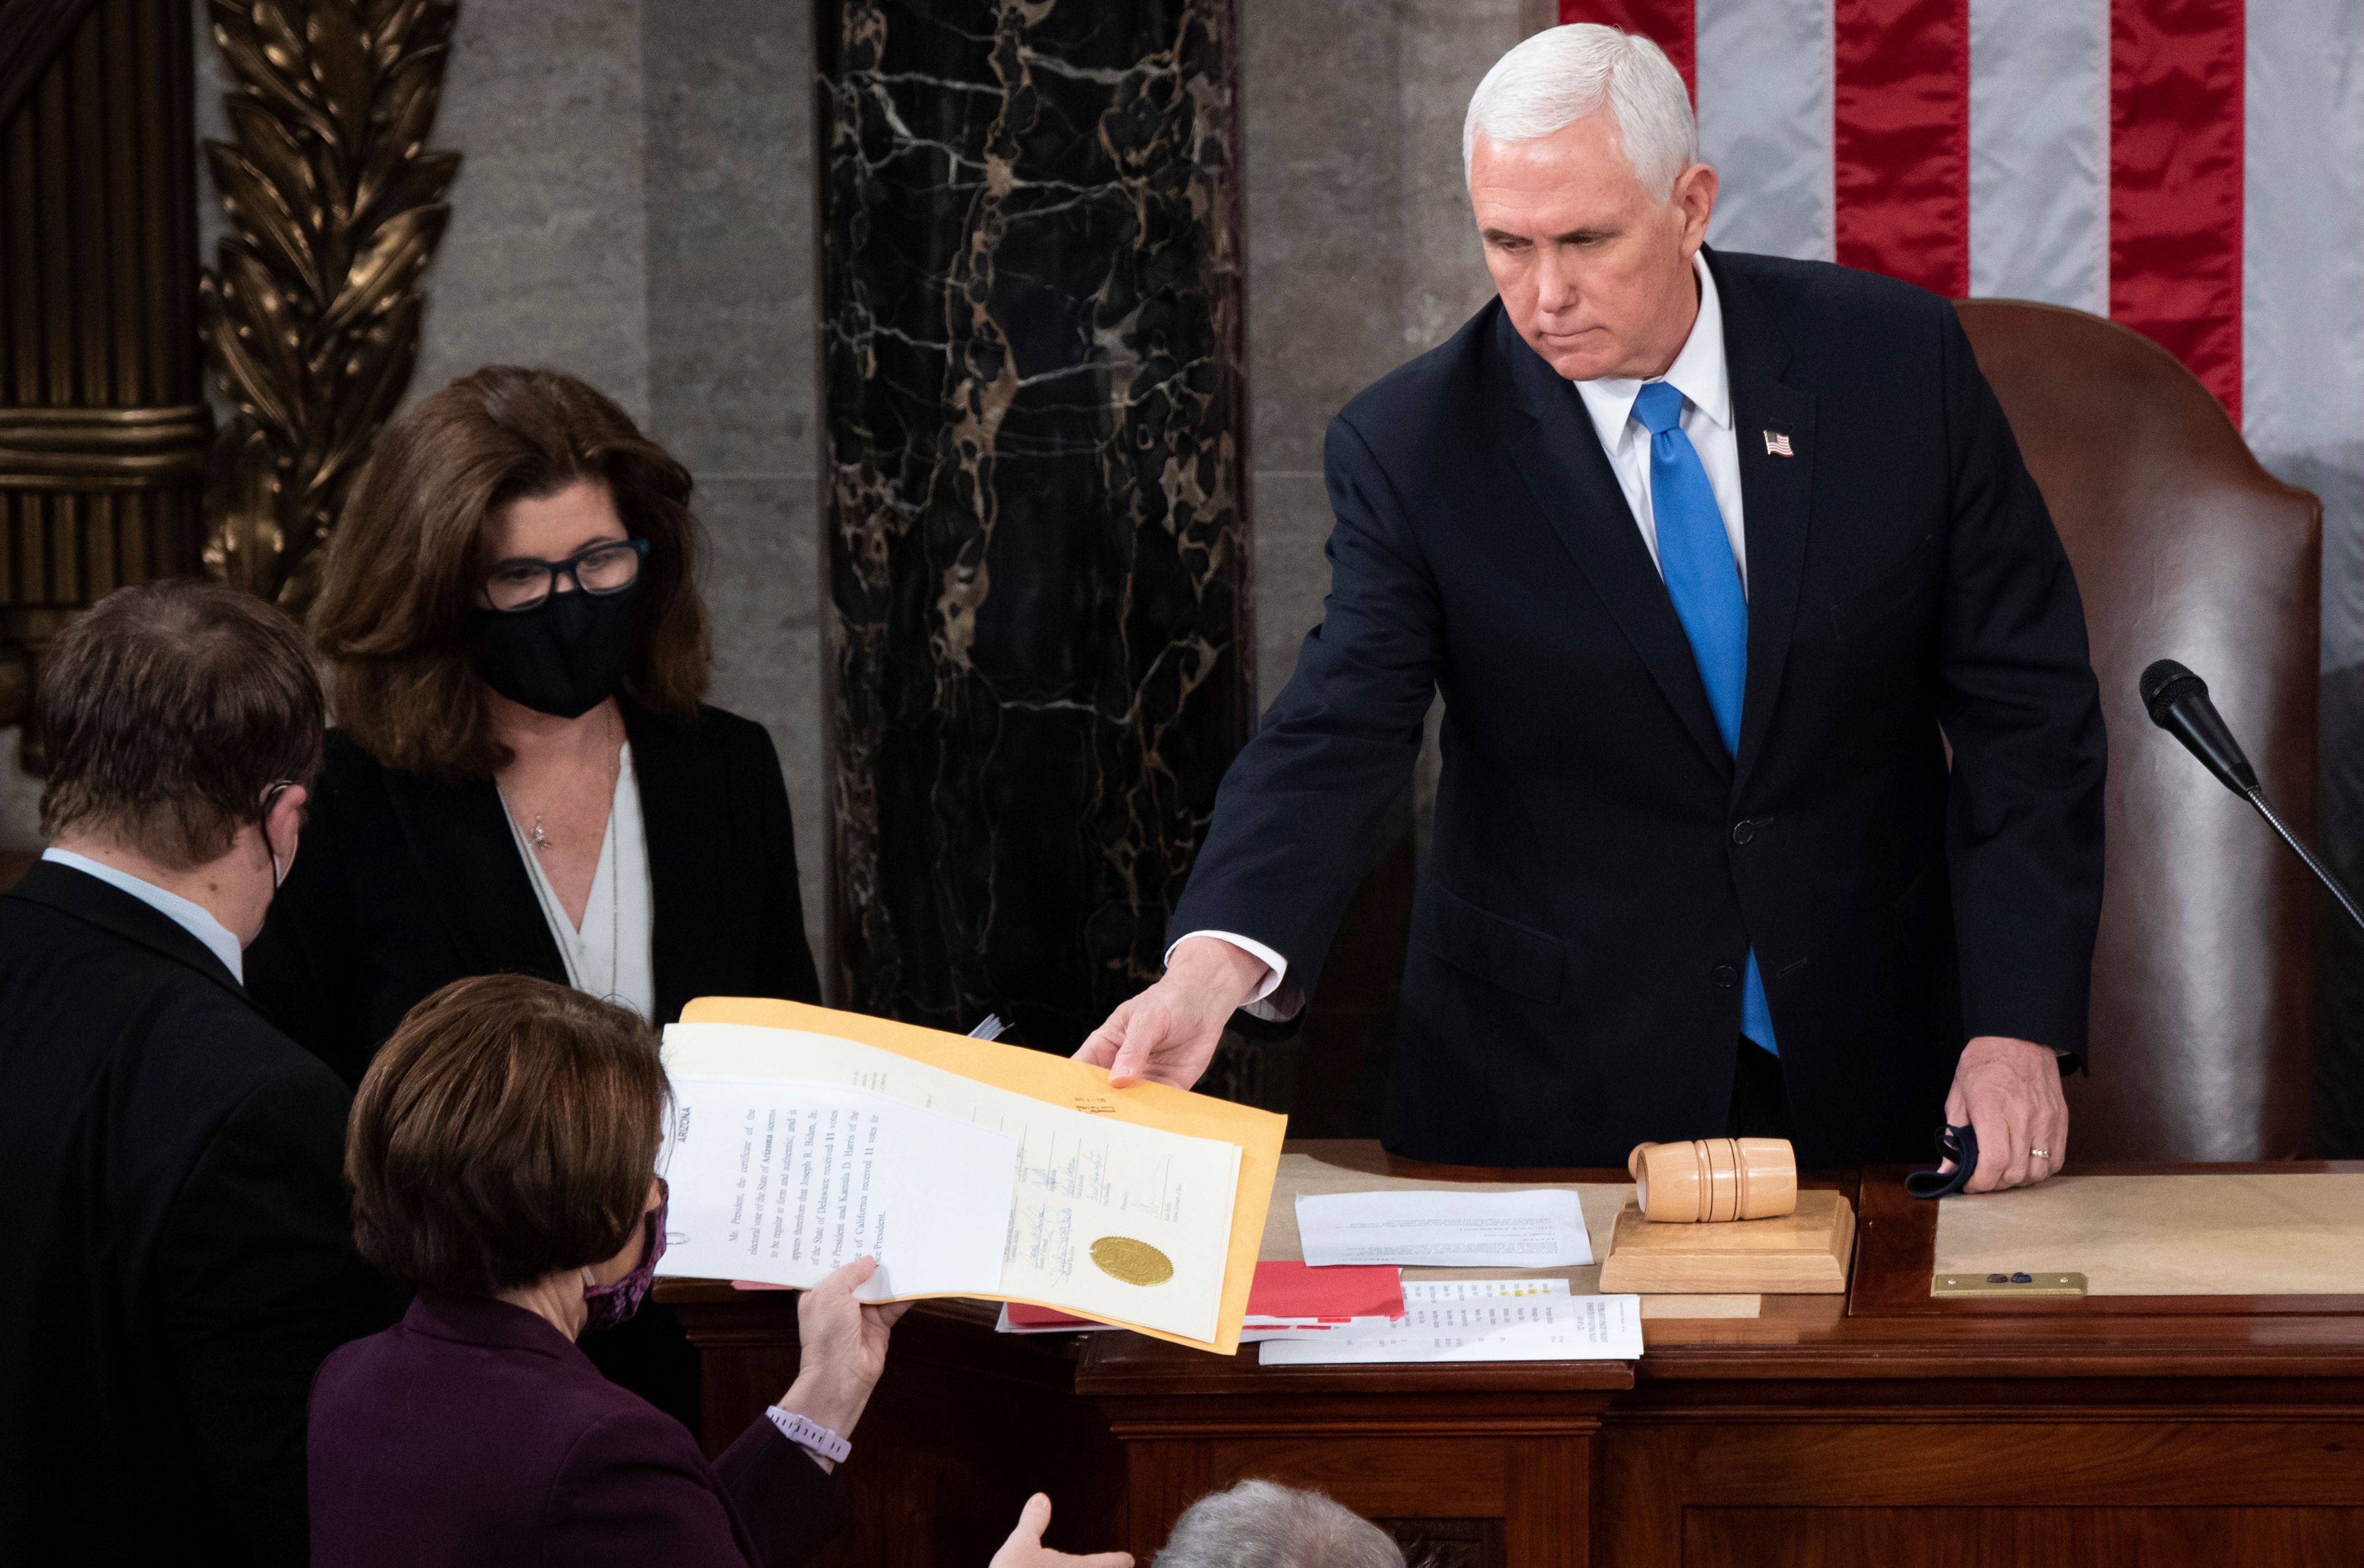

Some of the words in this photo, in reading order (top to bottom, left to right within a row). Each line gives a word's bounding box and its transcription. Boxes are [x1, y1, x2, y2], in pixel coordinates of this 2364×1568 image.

[746, 1108, 755, 1120] the
[768, 1108, 776, 1132] seems
[808, 1109, 817, 1119] Jr.
[830, 1109, 838, 1128] votes
[849, 1111, 859, 1120] the
[678, 1106, 691, 1143] ARIZONA
[744, 1125, 753, 1135] of
[787, 1117, 795, 1132] and
[848, 1122, 856, 1132] of
[805, 1122, 816, 1146] Biden,
[826, 1132, 835, 1141] 11
[869, 1127, 877, 1143] votes
[762, 1133, 773, 1163] Arizona
[782, 1135, 794, 1171] authentic,
[803, 1149, 812, 1158] R.
[843, 1134, 855, 1156] Harris
[740, 1141, 751, 1173] certificate
[823, 1144, 834, 1175] received
[842, 1160, 851, 1169] D.
[760, 1164, 769, 1173] of
[800, 1160, 813, 1186] Joseph
[862, 1160, 872, 1191] received
[736, 1178, 746, 1188] the
[757, 1174, 768, 1191] State
[780, 1173, 789, 1186] and
[838, 1172, 850, 1202] Kamala
[756, 1192, 765, 1202] the
[776, 1189, 786, 1205] form
[798, 1188, 808, 1202] that
[817, 1178, 829, 1213] Delaware
[731, 1193, 744, 1224] President,
[838, 1205, 846, 1220] and
[855, 1195, 867, 1234] California
[773, 1215, 783, 1238] regular
[793, 1204, 805, 1236] therefrom
[816, 1215, 825, 1224] of
[813, 1227, 823, 1244] State
[874, 1211, 885, 1250] President.
[749, 1227, 760, 1255] electoral
[770, 1240, 779, 1248] be
[832, 1223, 844, 1256] President
[854, 1239, 863, 1248] of
[792, 1237, 802, 1261] appears
[811, 1245, 821, 1256] the
